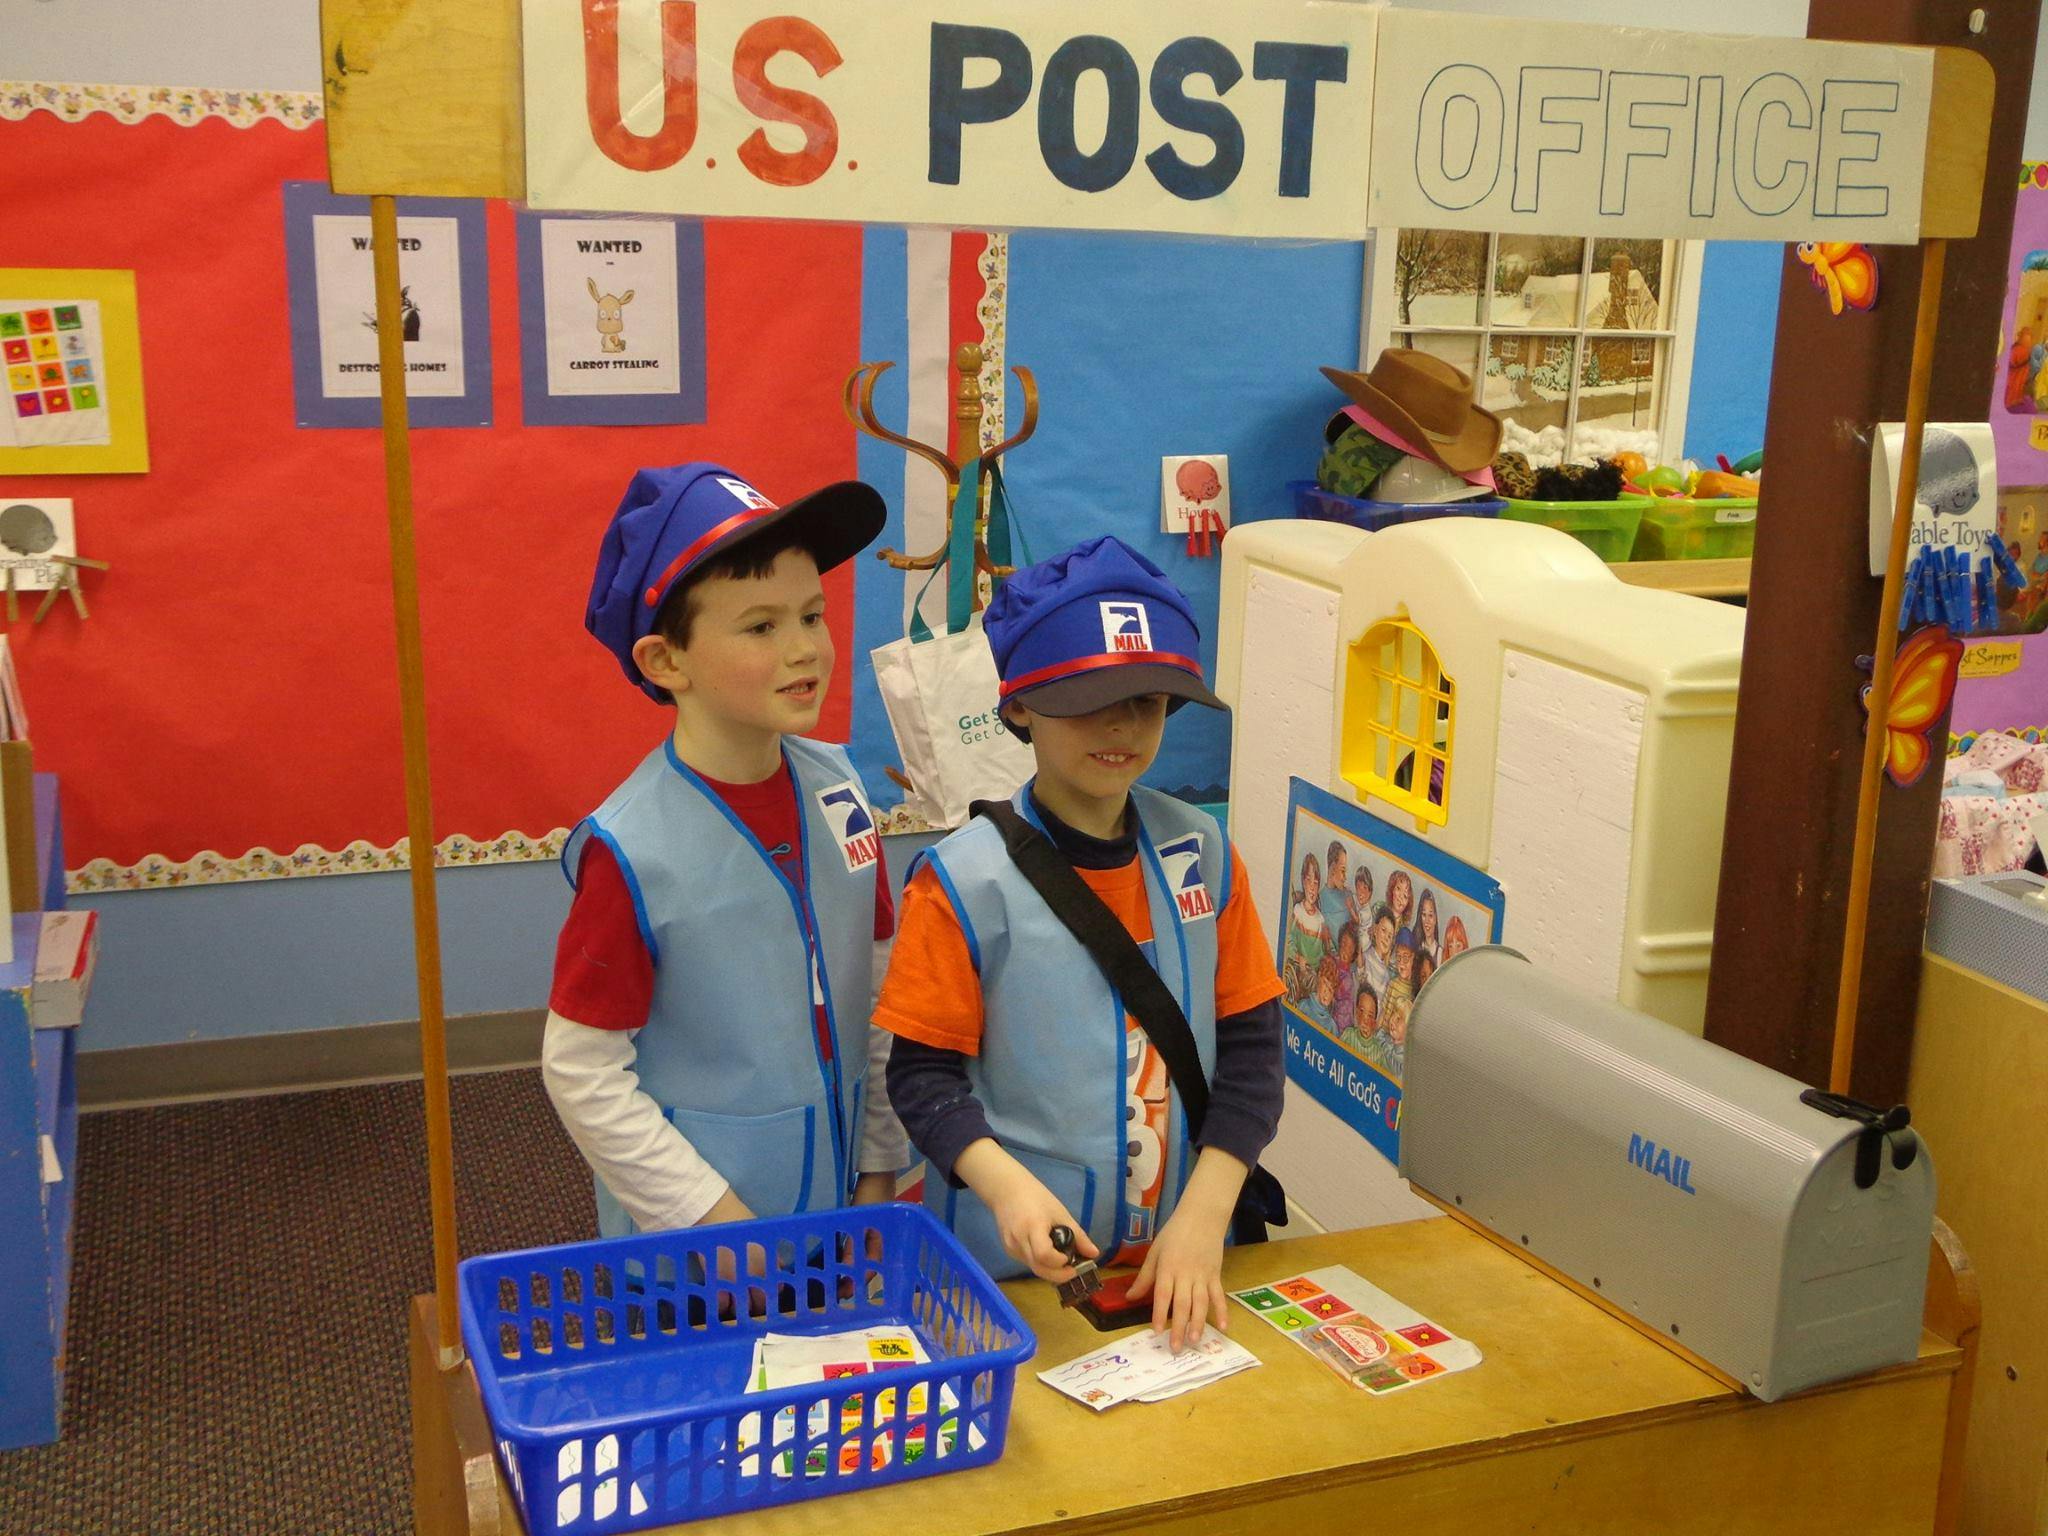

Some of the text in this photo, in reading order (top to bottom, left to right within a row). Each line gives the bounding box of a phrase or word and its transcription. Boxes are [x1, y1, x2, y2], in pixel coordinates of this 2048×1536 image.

[583, 0, 1900, 218] U.S. POST OFFICE
[351, 237, 422, 251] WED
[576, 240, 642, 253] WANTED
[338, 362, 447, 373] DESTRO HOMES
[569, 359, 660, 370] CARROT STEALING
[1911, 521, 1950, 545] able
[1113, 634, 1149, 652] MAIL
[958, 712, 990, 730] Get
[961, 730, 990, 745] Get
[1175, 888, 1214, 920] MAI
[1286, 1023, 1301, 1055] We
[1303, 1040, 1326, 1074] Are
[1328, 1058, 1345, 1088] All
[1347, 1071, 1381, 1115] God's
[1627, 1131, 1697, 1196] MAIL
